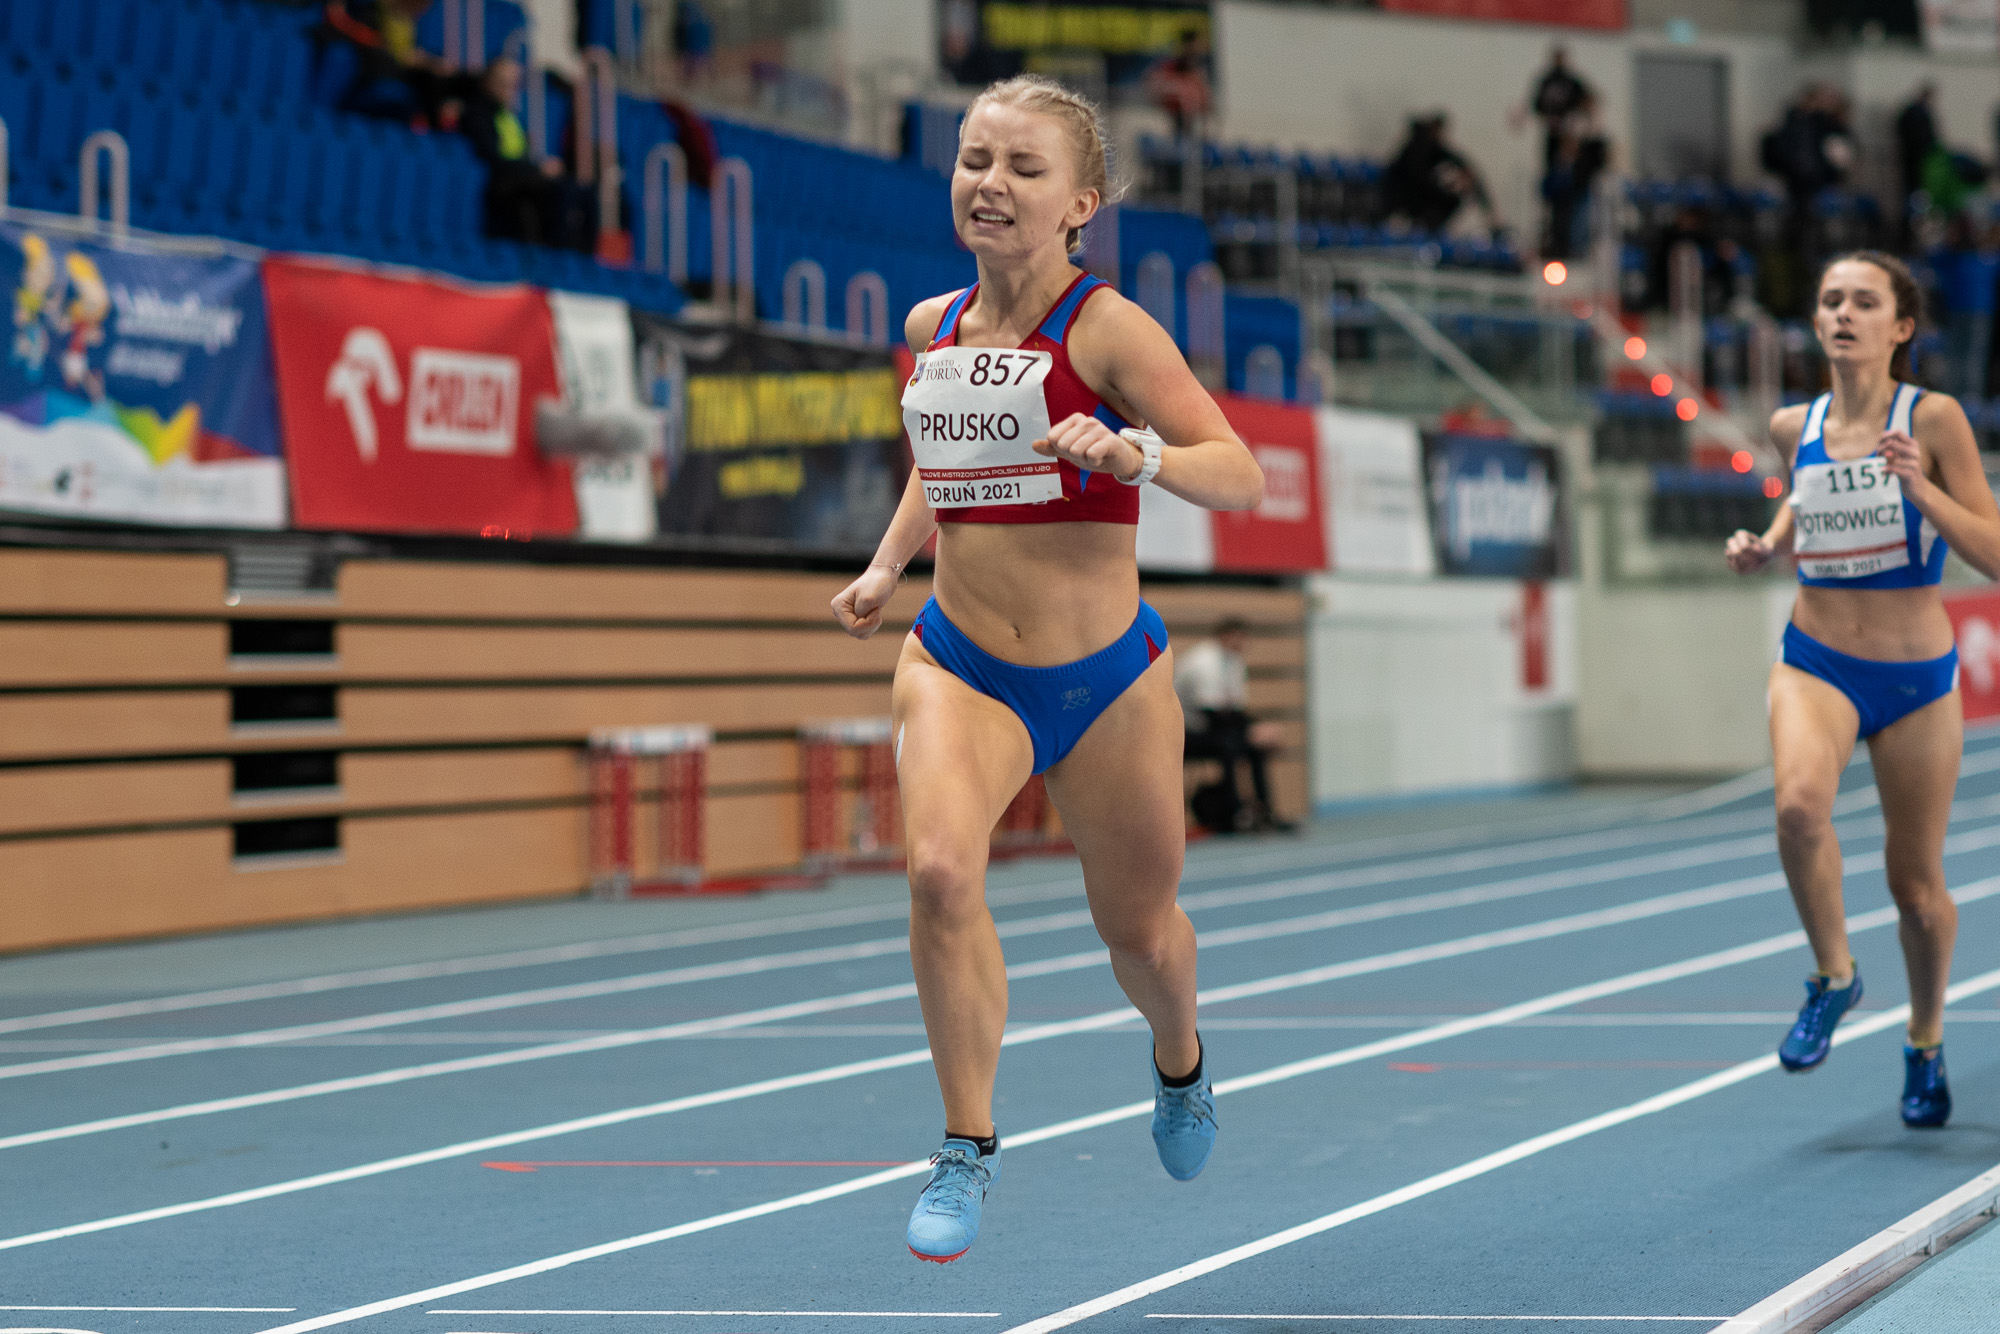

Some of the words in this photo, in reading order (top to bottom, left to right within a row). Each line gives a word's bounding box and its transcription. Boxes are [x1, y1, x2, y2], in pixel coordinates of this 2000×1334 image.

[925, 364, 963, 381] TORUŃ
[929, 359, 954, 368] MIASTO
[969, 353, 1040, 386] 857
[920, 412, 1020, 441] PRUSKO
[991, 467, 1019, 476] POLSKI
[1826, 463, 1893, 494] 1157
[926, 482, 977, 503] TORUŃ
[981, 483, 1021, 500] 2021
